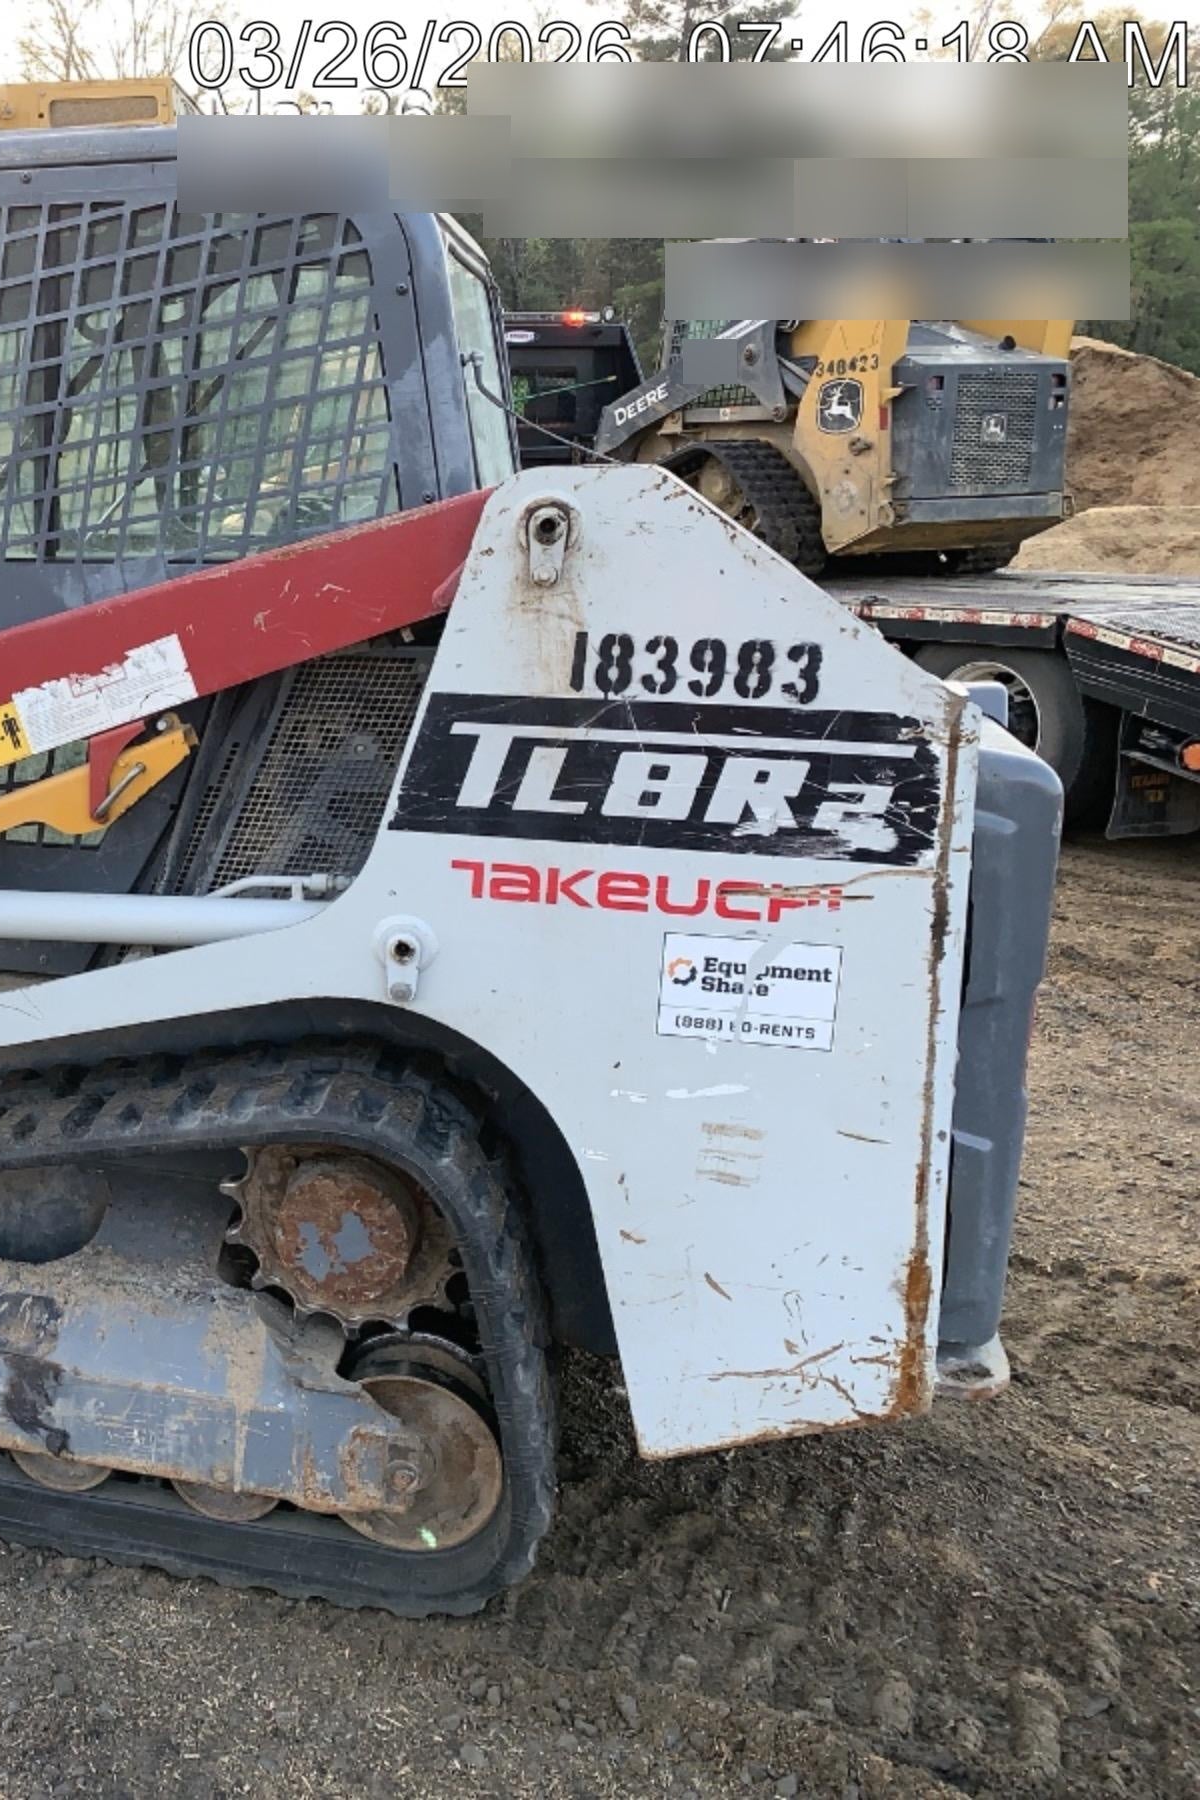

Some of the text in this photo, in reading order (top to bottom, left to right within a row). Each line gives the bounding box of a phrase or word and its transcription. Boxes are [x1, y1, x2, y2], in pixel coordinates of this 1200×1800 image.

[614, 382, 669, 426] DEERE
[569, 631, 824, 704] 183983
[703, 956, 833, 984] Equpment
[701, 975, 769, 997] Shae
[674, 1014, 723, 1032] (888)
